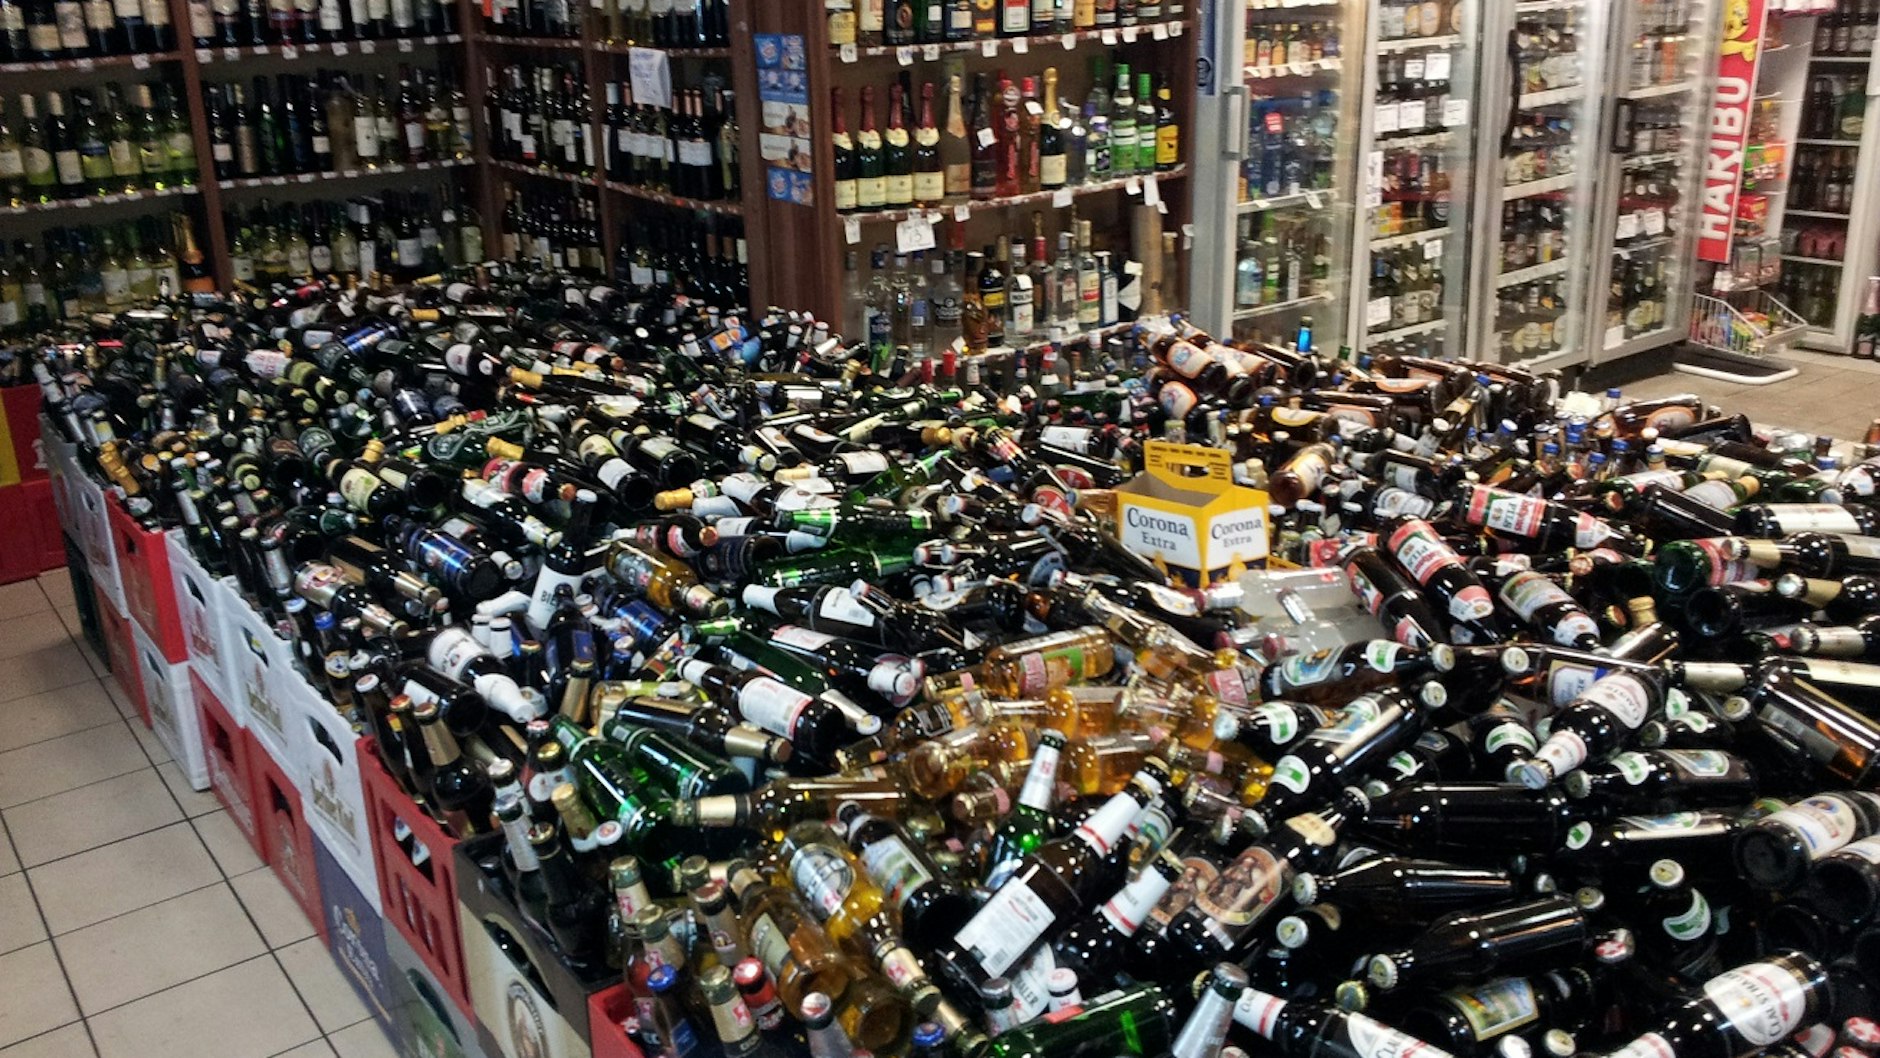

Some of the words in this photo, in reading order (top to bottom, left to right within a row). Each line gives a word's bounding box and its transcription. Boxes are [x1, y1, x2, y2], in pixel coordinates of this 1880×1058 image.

[1127, 507, 1188, 536] Corona
[1211, 517, 1263, 540] Corona
[1142, 531, 1177, 551] Extra
[1223, 534, 1252, 549] Extra
